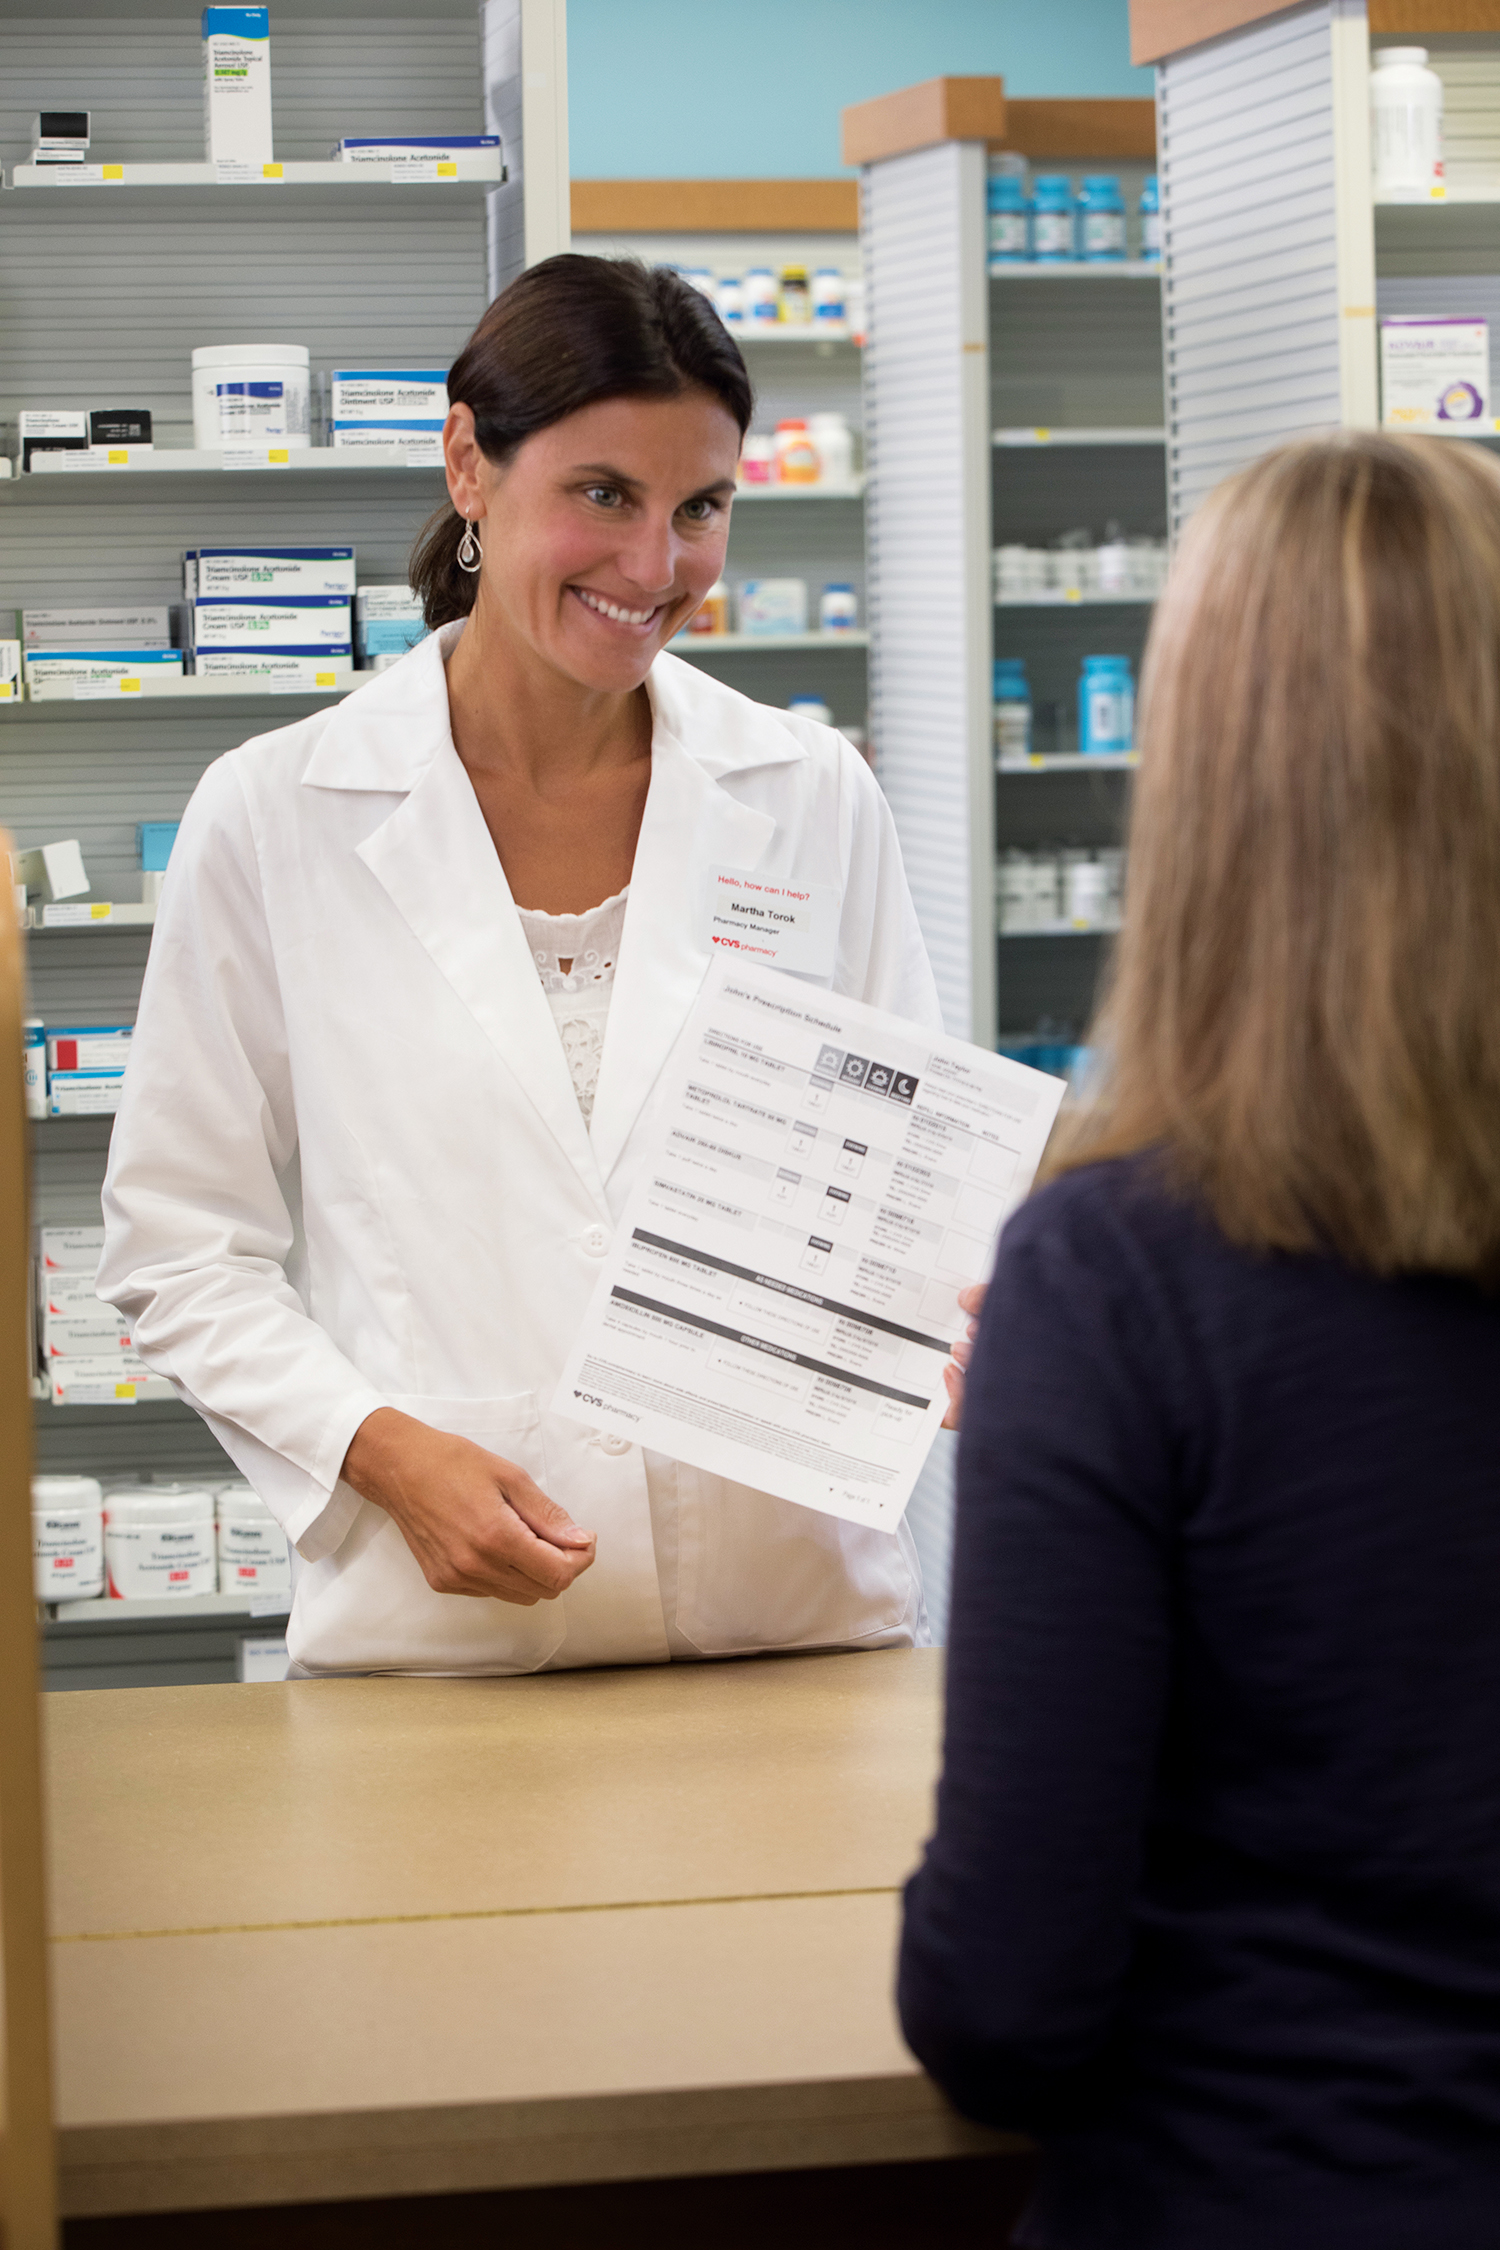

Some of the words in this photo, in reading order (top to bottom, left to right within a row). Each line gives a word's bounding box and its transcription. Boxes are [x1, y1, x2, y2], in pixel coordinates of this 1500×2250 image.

[351, 154, 407, 162] Triamcinolone
[410, 153, 450, 161] Acetonide
[340, 389, 394, 397] Triamcinolone
[263, 565, 301, 573] Acetonide
[203, 613, 256, 621] Triamcinolone
[34, 668, 87, 676] Triamcinolone
[204, 662, 258, 671] Triamcinolone
[261, 662, 299, 670] Acetonide
[718, 875, 742, 888] Hello,
[744, 881, 762, 891] how
[764, 886, 780, 895] can
[786, 889, 811, 901] help?
[731, 903, 765, 917] Martha
[768, 910, 795, 924] Torok
[713, 915, 748, 930] Pharmacy
[749, 923, 780, 936] Manager
[720, 937, 741, 949] CVS
[740, 942, 777, 958] pharmacy
[723, 984, 751, 1001] John's
[752, 994, 803, 1019] Prescription
[803, 1013, 843, 1033] Schedule
[581, 1393, 603, 1407] CVS
[602, 1401, 641, 1423] pharmacy
